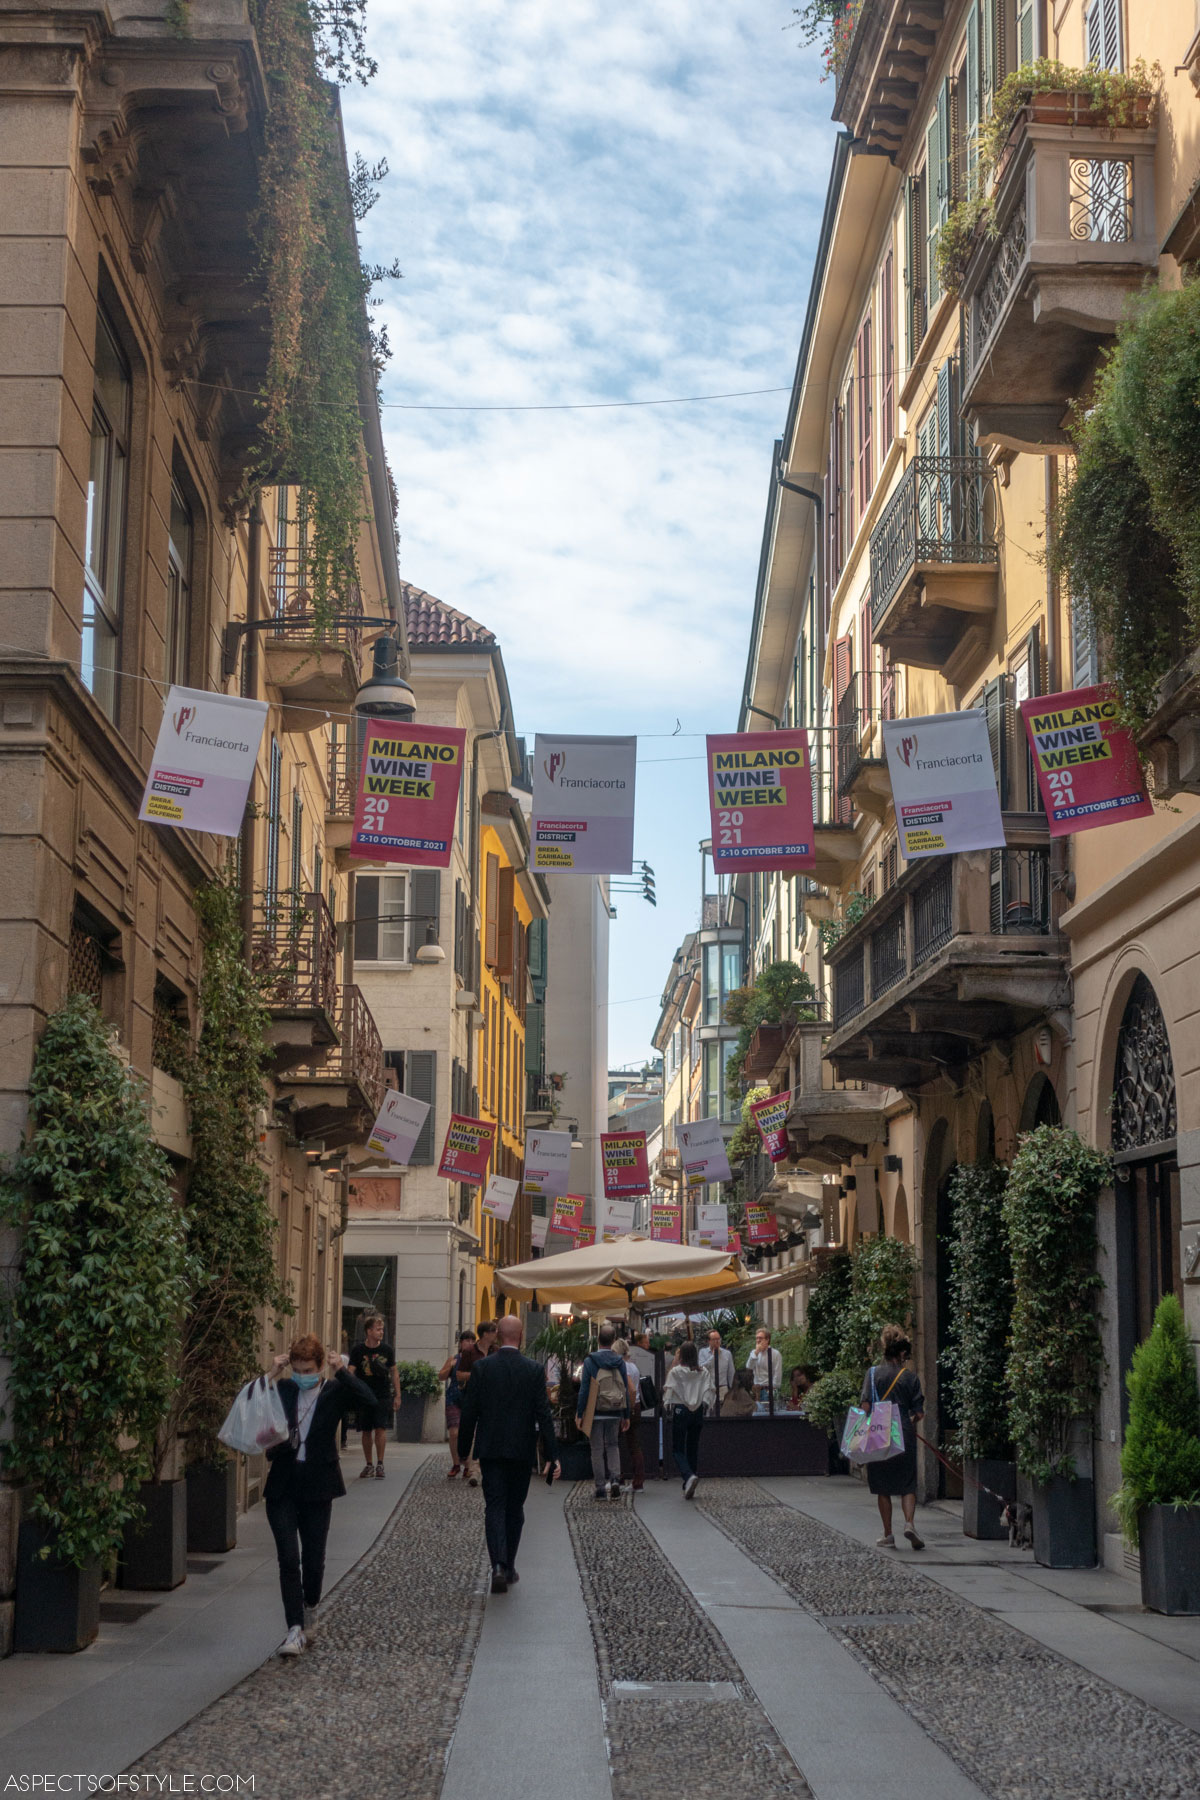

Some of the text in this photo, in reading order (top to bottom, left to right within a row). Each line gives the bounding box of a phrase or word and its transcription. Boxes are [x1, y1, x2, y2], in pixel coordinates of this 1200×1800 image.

[185, 731, 249, 753] Franciacorta
[1037, 725, 1097, 750] WINE
[371, 740, 455, 762] MILANO
[1041, 742, 1109, 769] WEEK
[716, 750, 800, 769] MILANO
[916, 753, 983, 771] Franciacorta
[370, 758, 427, 778] WINE
[157, 773, 200, 786] Franciacorta
[560, 776, 626, 789] Franciacorta
[716, 770, 775, 788] WINE
[1047, 770, 1073, 789] 20
[154, 783, 188, 794] DISTRICT
[367, 777, 431, 797] WEEK
[150, 796, 171, 804] BRERA
[718, 788, 783, 807] WEEK
[1051, 788, 1076, 807] 21
[149, 802, 182, 813] GARIBALDI
[364, 797, 389, 814] 20
[903, 803, 949, 814] Franciacorta
[1055, 794, 1141, 819] 2-10 OTTOBRE 2021
[148, 809, 181, 820] SOLFERINO
[719, 811, 744, 827] 20
[905, 815, 940, 826] DISTRICT
[362, 814, 385, 831] 21
[539, 822, 584, 830] Franciacorta
[539, 833, 573, 841] DISTRICT
[720, 828, 742, 845] 21
[907, 830, 929, 838] BRERA
[908, 835, 942, 845] GARIBALDI
[360, 834, 444, 850] 2-10 OTTOBRE 2021
[909, 842, 944, 852] SOLFERINO
[720, 845, 806, 857] 2-10 OTTOBRE 2021
[759, 1112, 785, 1127] WINE
[452, 1123, 490, 1138] MILANO
[762, 1120, 785, 1134] WEE
[451, 1131, 477, 1144] WINE
[766, 1133, 778, 1143] 20
[449, 1140, 478, 1153] WEEK
[605, 1140, 643, 1150] MILANO
[769, 1140, 780, 1150] 21
[446, 1149, 458, 1158] 20
[605, 1149, 632, 1158] WINE
[444, 1157, 456, 1166] 21
[606, 1157, 635, 1167] WEEK
[606, 1168, 618, 1176] 20
[607, 1176, 618, 1185] 21
[556, 1202, 574, 1210] WINE
[557, 1197, 582, 1206] MILANO
